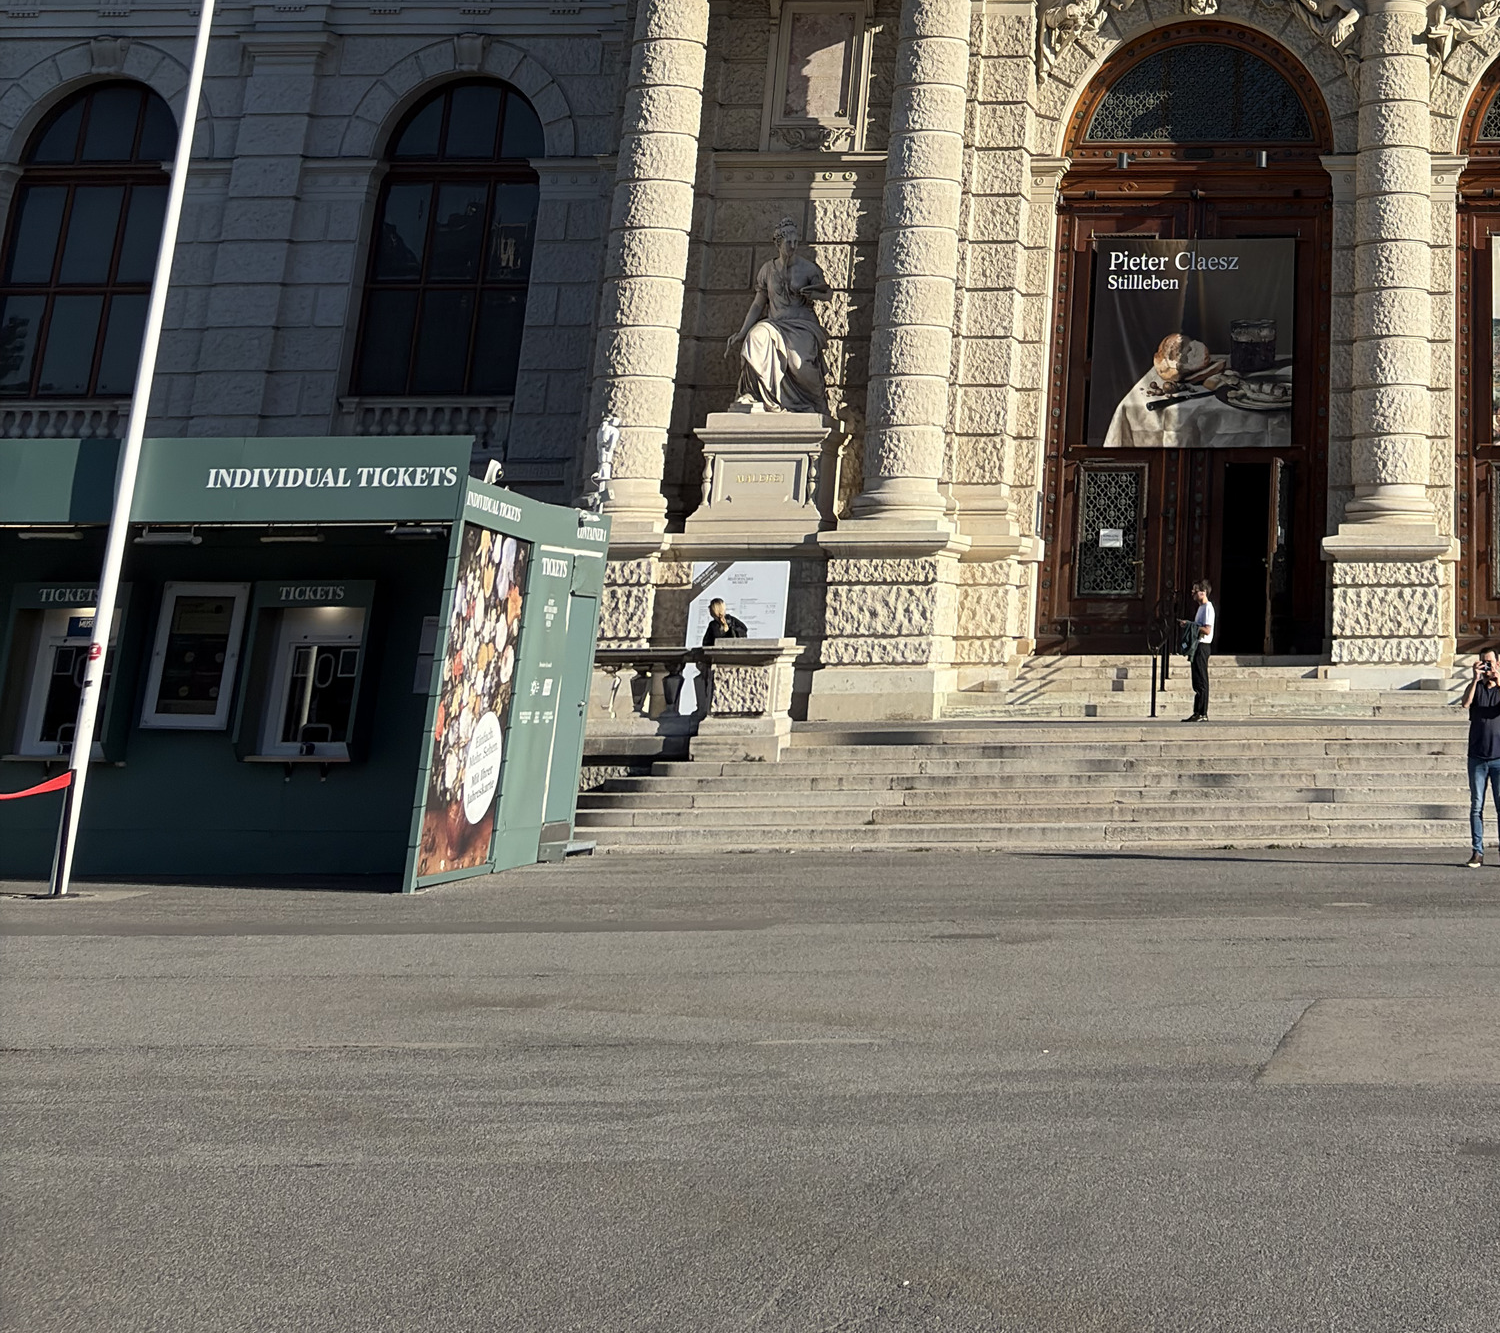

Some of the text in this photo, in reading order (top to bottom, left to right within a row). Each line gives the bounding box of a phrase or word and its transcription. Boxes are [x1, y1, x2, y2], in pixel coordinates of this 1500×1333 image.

[1109, 251, 1239, 271] Pieter Claesz
[1107, 274, 1180, 290] Stillleben
[206, 466, 458, 489] INDIVIDUAL TICKETS
[736, 474, 785, 483] MALEREI
[466, 491, 521, 522] INDIVIDUAL TICKETS
[576, 527, 604, 542] CONTAINER
[541, 558, 569, 578] TICKETS
[279, 586, 344, 601] TICKETS
